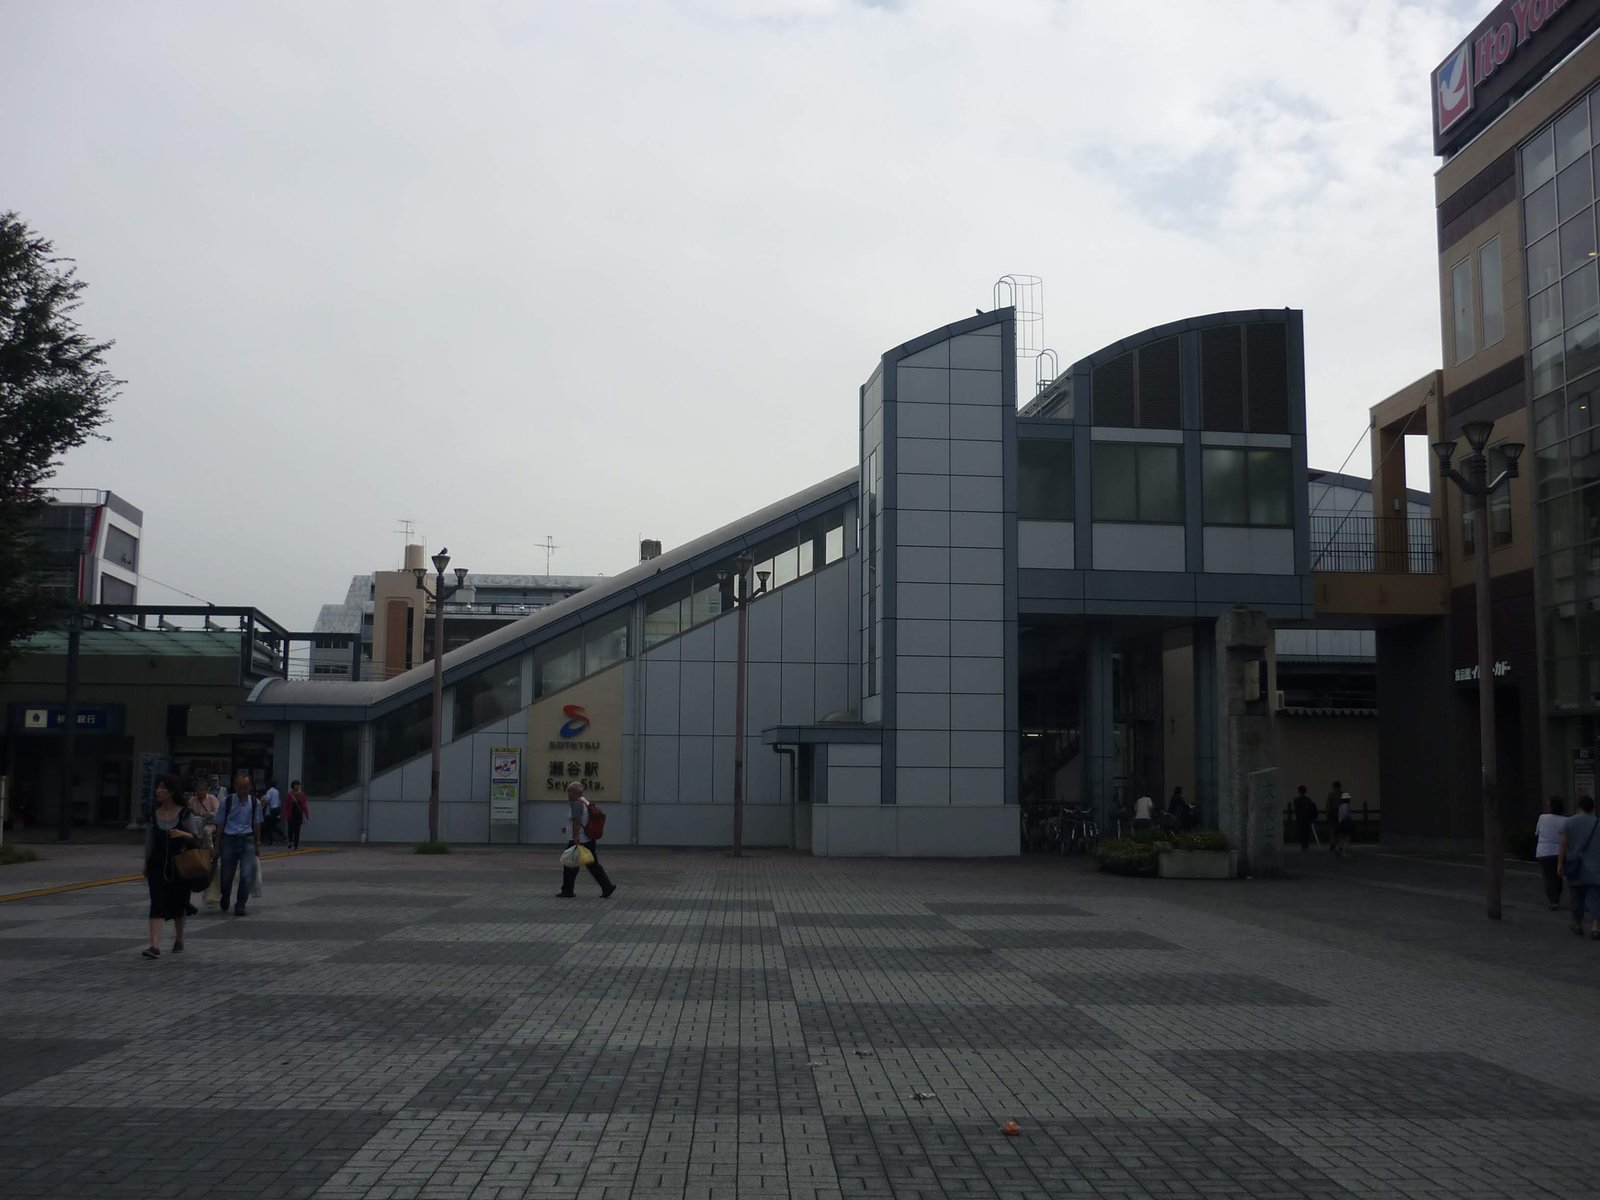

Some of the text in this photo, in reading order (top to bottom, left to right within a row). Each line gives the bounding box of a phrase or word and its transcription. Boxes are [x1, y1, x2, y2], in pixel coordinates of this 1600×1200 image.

[549, 741, 600, 750] SOTETSU
[549, 761, 599, 777] 瀬谷駅
[547, 778, 604, 792] Sey Sta.
